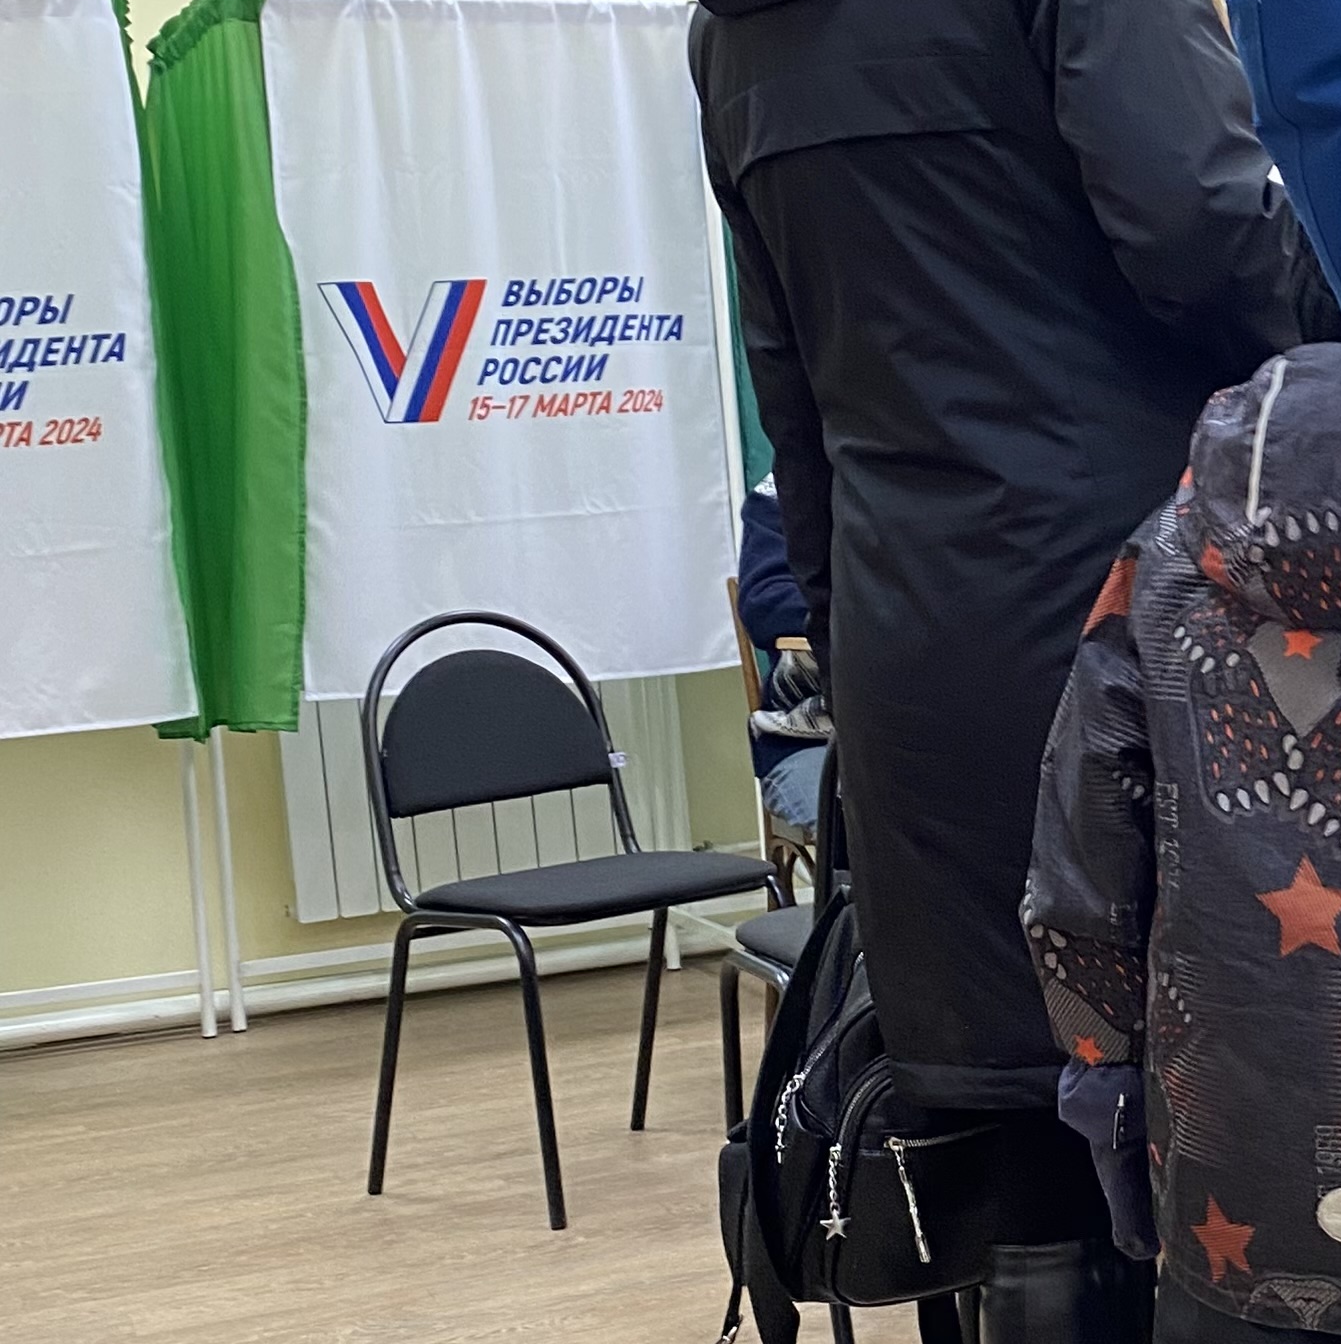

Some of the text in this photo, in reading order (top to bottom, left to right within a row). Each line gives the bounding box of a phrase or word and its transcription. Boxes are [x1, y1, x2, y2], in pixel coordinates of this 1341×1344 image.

[501, 276, 644, 307] ВЫБОРЫ
[490, 314, 684, 347] ПРЕЗИДЕНТА
[477, 353, 610, 386] РОССИИ
[531, 390, 613, 418] МАРТА
[616, 389, 664, 413] 2024
[38, 417, 102, 445] 2024
